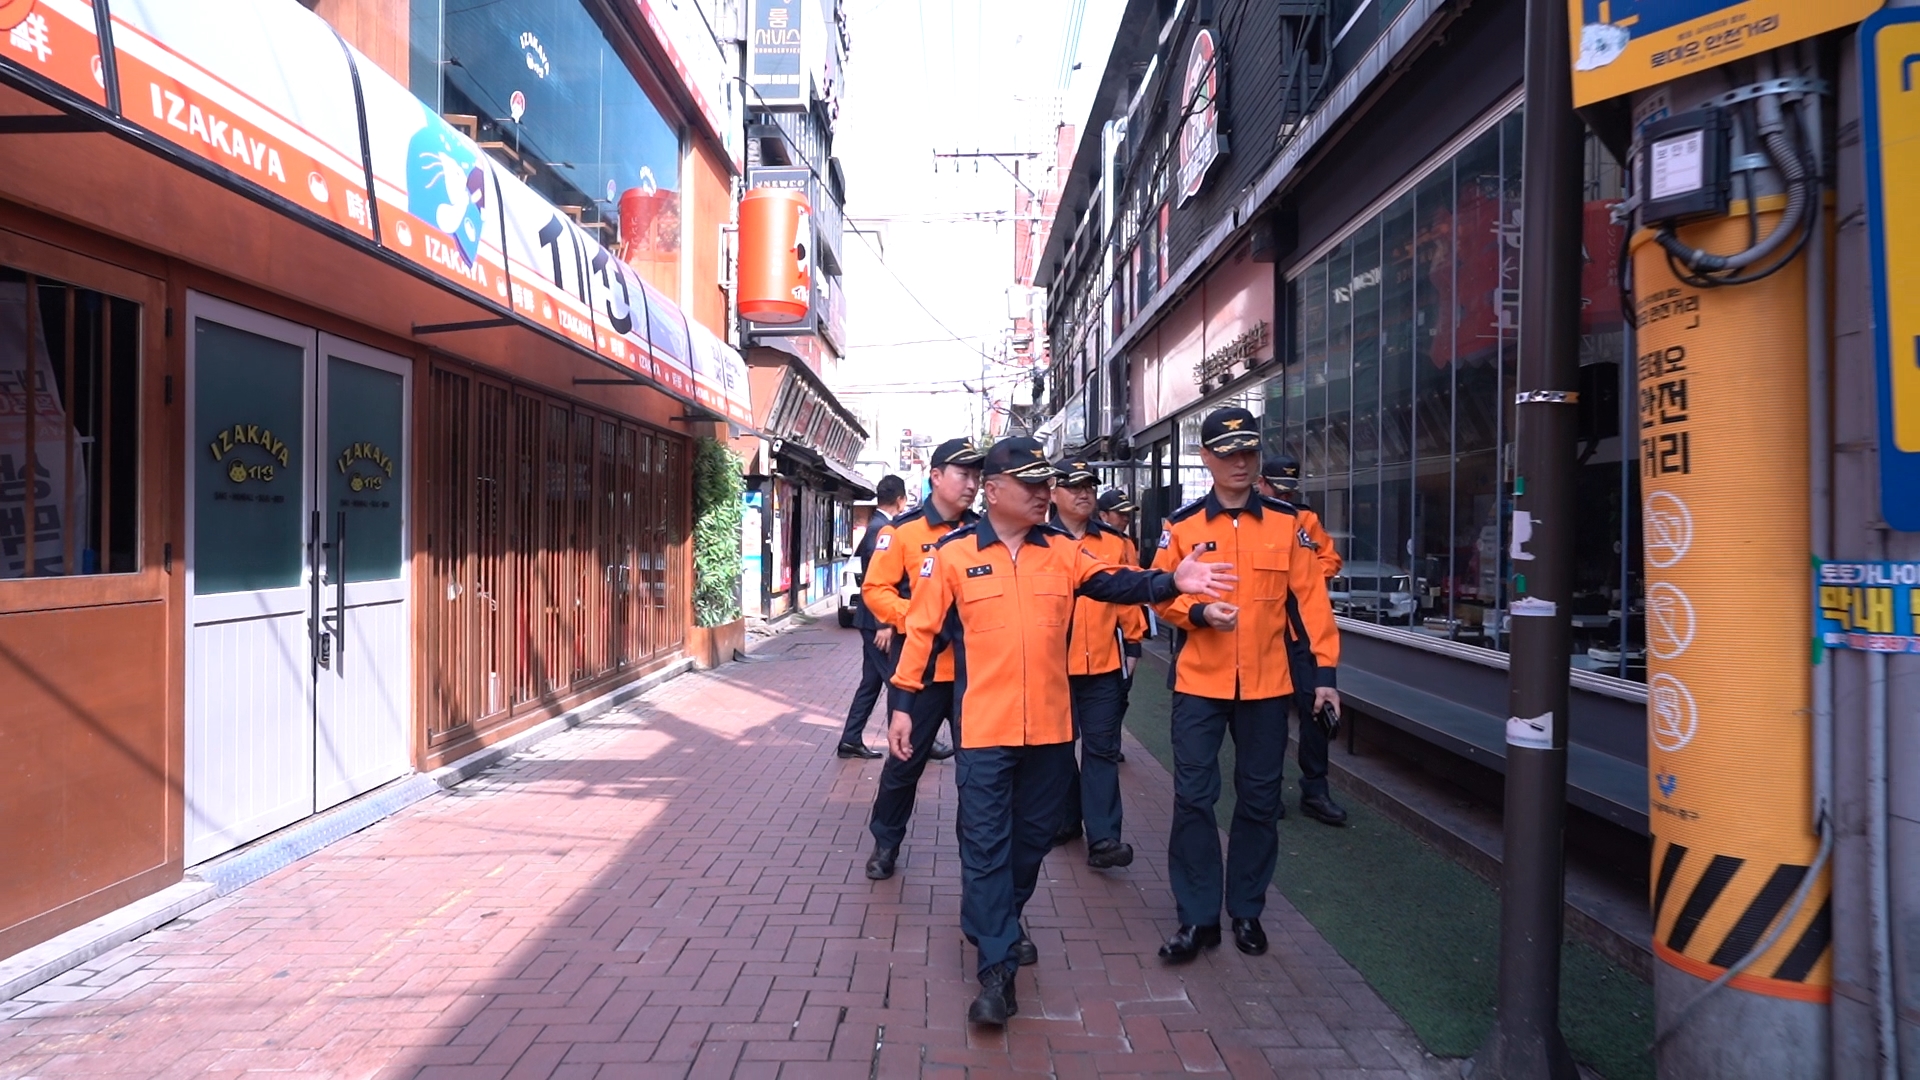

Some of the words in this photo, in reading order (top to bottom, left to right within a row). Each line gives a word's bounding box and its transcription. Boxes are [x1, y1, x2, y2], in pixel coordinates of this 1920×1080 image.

[1650, 41, 1700, 69] 로데오
[1704, 13, 1780, 51] 안전거리
[149, 82, 287, 183] IZAKAYA
[345, 190, 374, 231] 時
[1641, 377, 1689, 430] 안전
[210, 424, 290, 468] IZAKAYA
[336, 442, 394, 479] IZAKAYA
[1641, 431, 1691, 479] 거리
